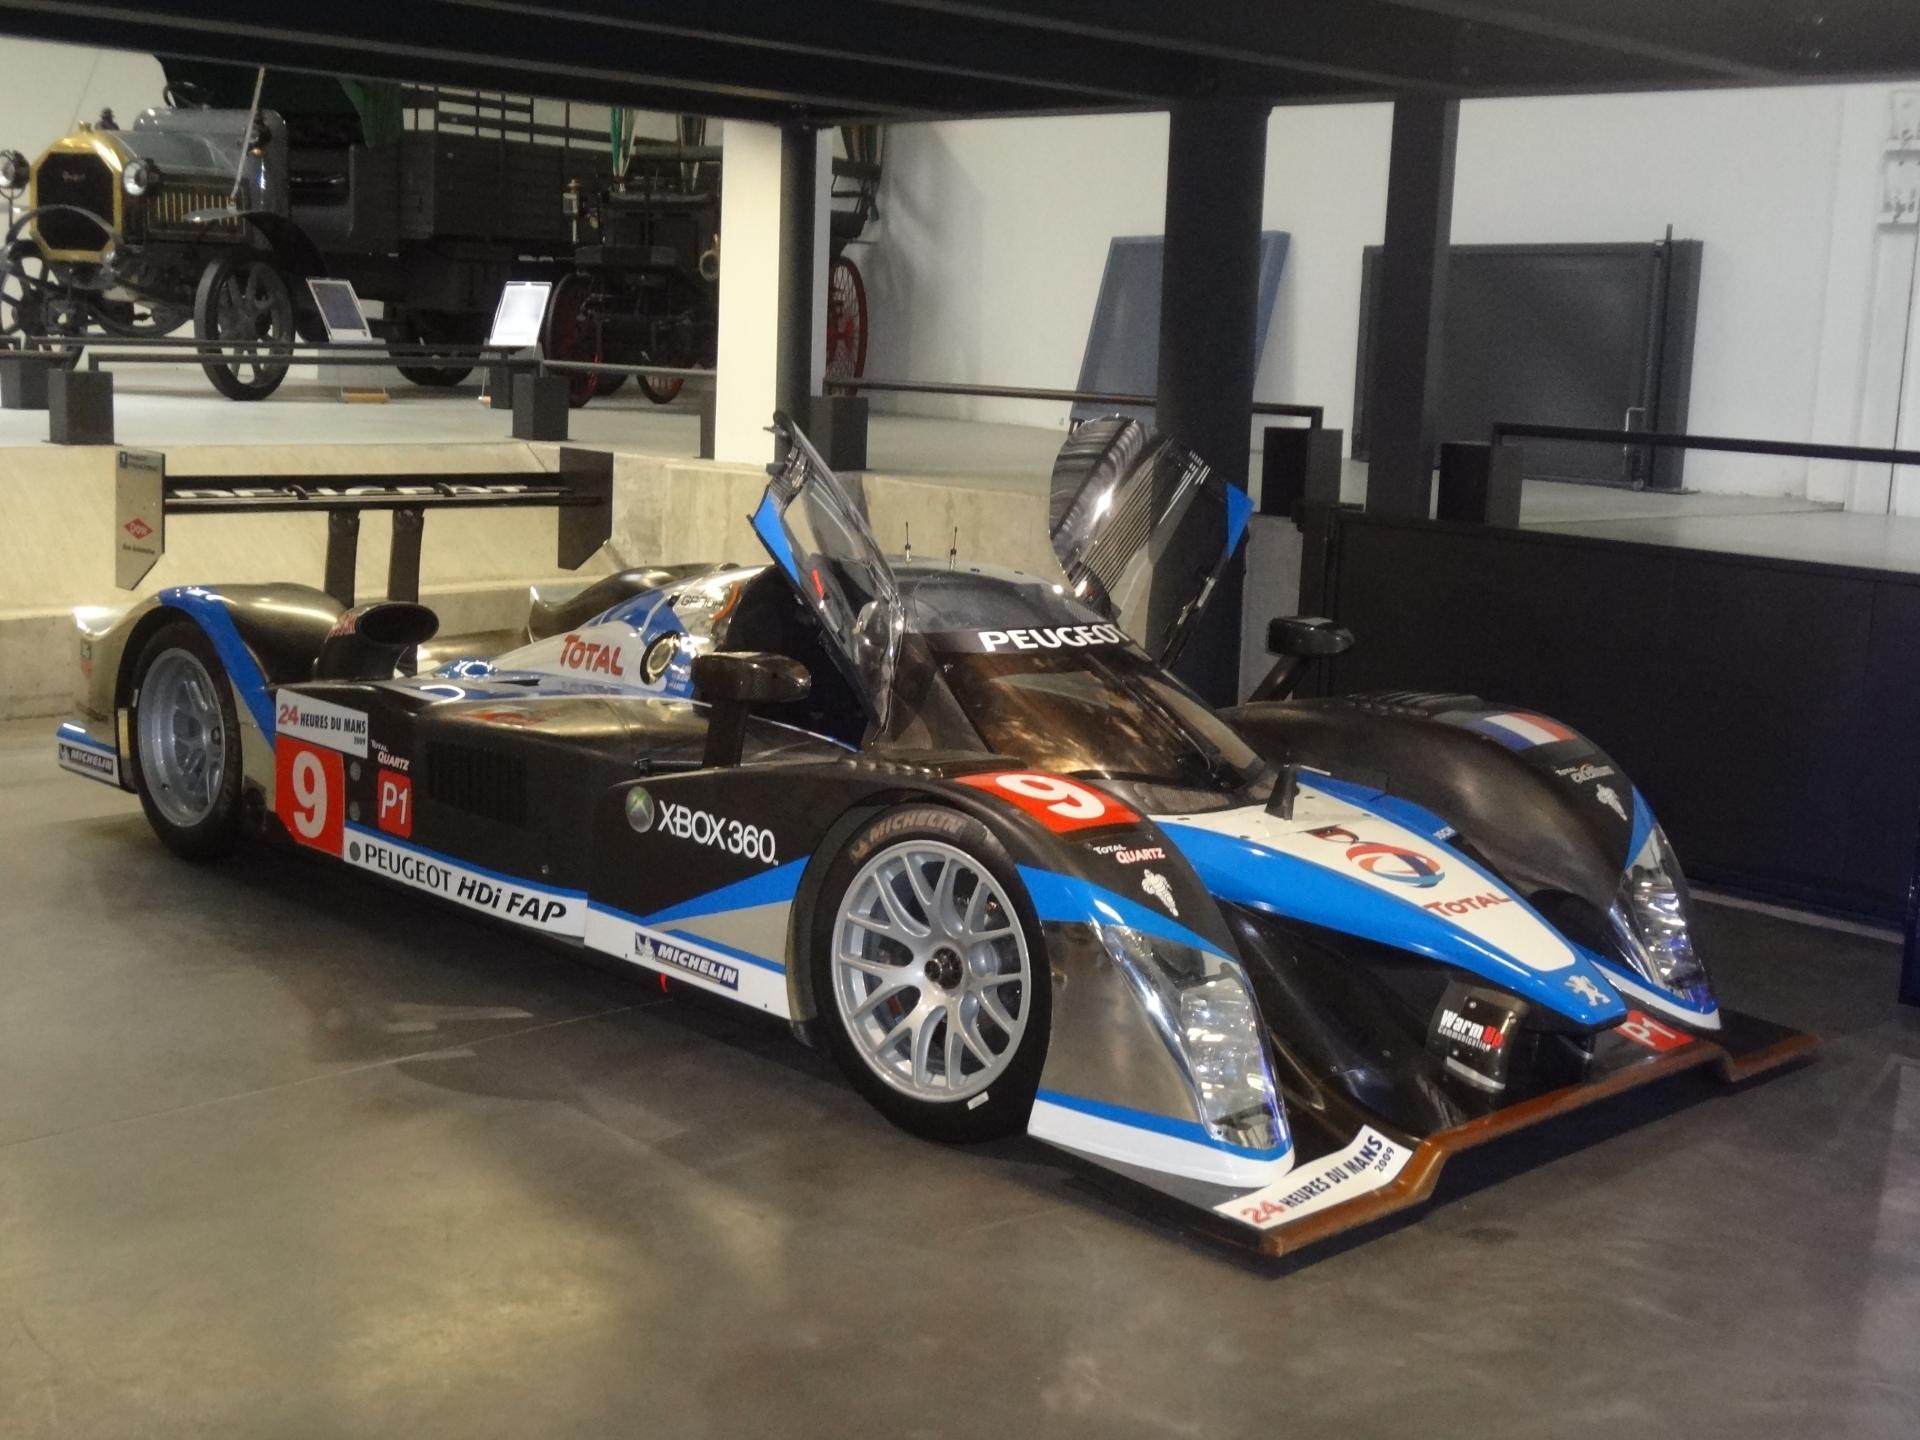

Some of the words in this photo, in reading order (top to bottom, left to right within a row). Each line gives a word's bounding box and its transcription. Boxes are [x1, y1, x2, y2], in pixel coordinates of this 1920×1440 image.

[978, 623, 1130, 652] PEUGEOT
[560, 634, 624, 676] TOTAL
[278, 704, 299, 725] 24
[300, 712, 329, 730] HEURES
[331, 717, 342, 732] DU
[343, 718, 367, 735] MANS
[70, 749, 113, 771] MICHELIN
[377, 751, 411, 772] QUARTZ
[292, 750, 328, 838] 9
[381, 781, 408, 825] P1
[995, 774, 1105, 819] 9
[869, 808, 962, 842] MICHELIN
[1115, 847, 1167, 864] QUARTZ
[364, 842, 452, 892] PEUGEOT
[456, 875, 502, 909] HDi
[505, 892, 567, 923] FAP
[1424, 892, 1512, 916] TOTAL
[657, 943, 737, 985] MICHELIN
[1618, 1016, 1676, 1047] P1
[1374, 1146, 1395, 1173] 2009
[1241, 1199, 1287, 1224] 24
[1278, 1176, 1331, 1208] HEURES
[1325, 1166, 1349, 1184] DU
[1343, 1135, 1384, 1175] MANS
